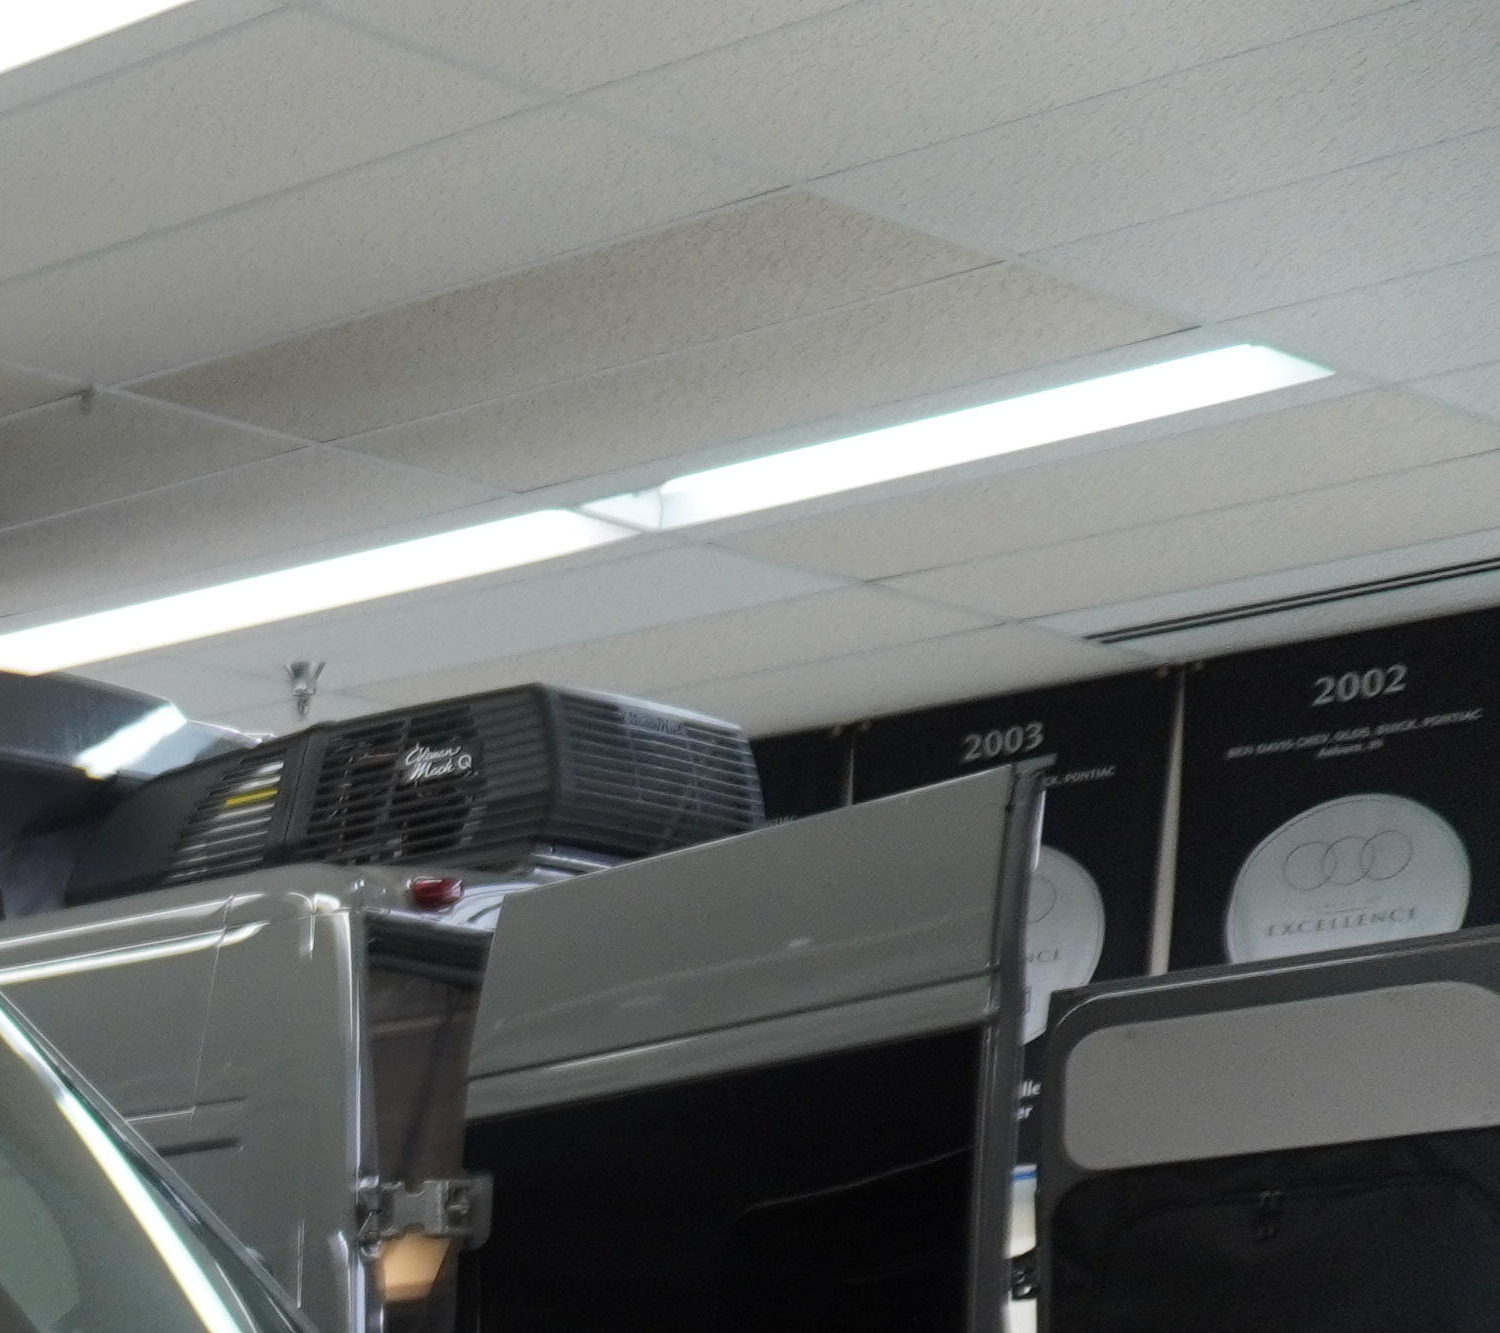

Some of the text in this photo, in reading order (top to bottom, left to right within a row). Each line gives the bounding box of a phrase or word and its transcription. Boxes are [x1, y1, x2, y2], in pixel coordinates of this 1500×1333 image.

[1312, 663, 1409, 707] 2002
[964, 720, 1045, 762] 2003
[458, 754, 472, 770] Q
[1267, 907, 1417, 937] EXCELLENCE
